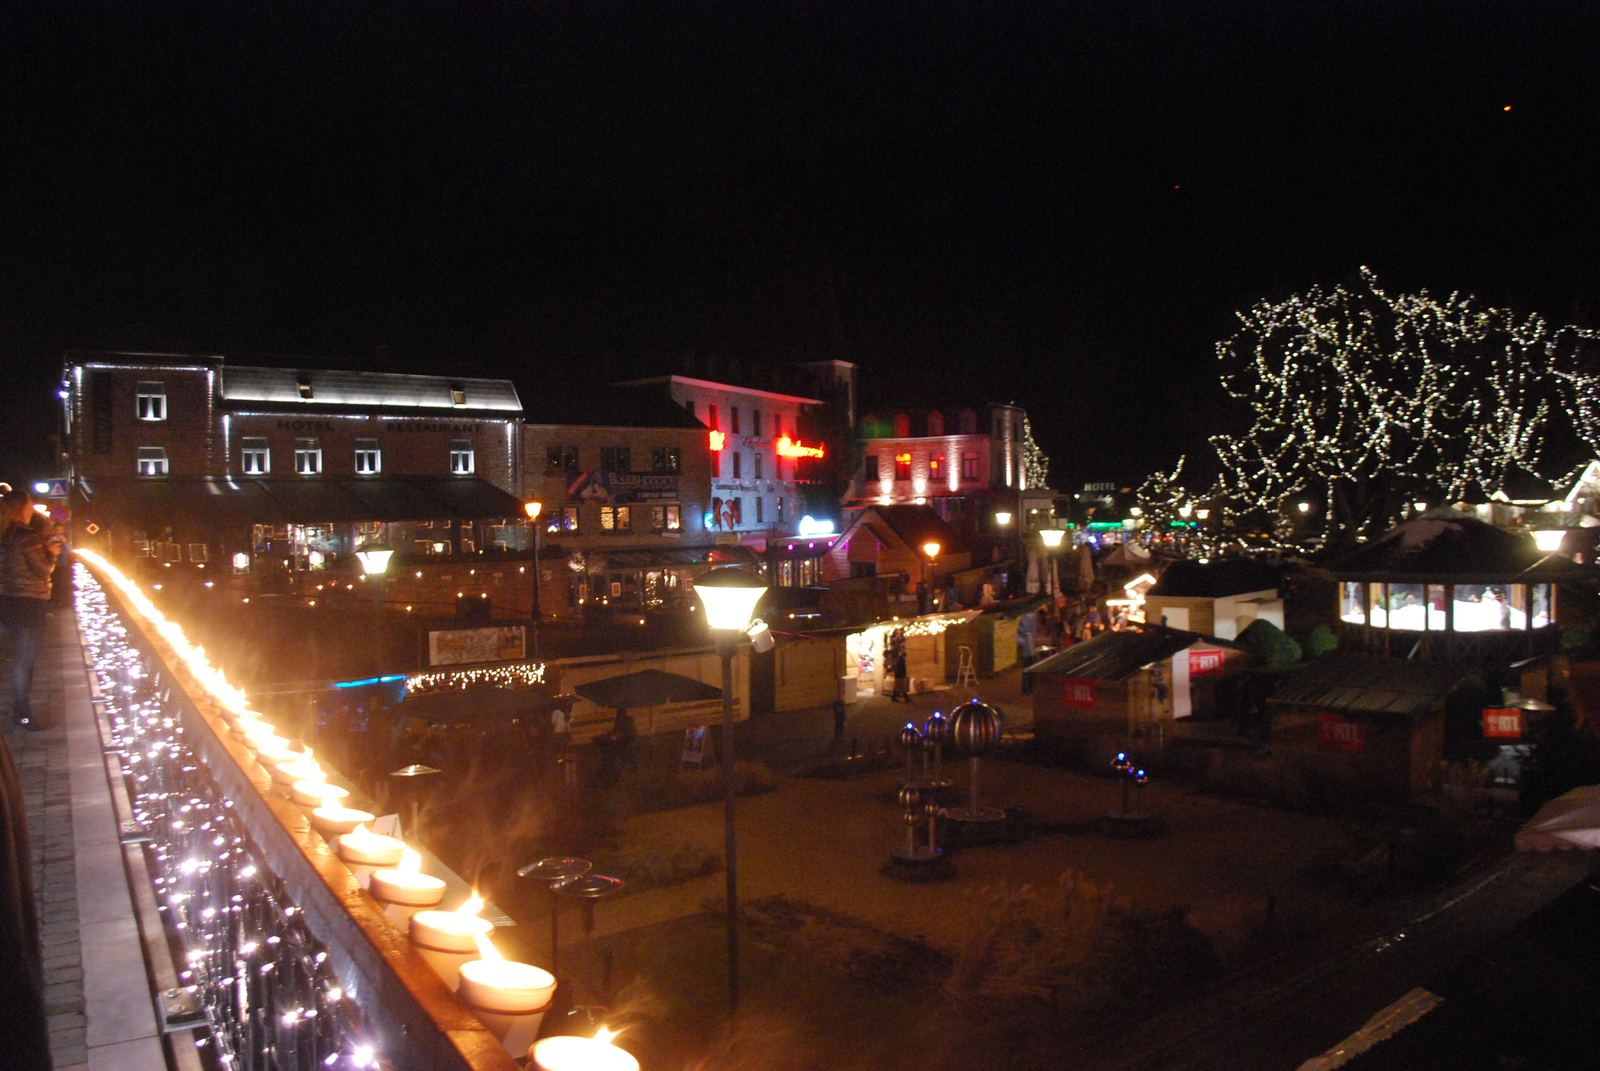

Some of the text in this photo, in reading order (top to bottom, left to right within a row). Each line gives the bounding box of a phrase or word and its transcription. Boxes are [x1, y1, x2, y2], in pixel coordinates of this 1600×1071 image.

[277, 419, 483, 433] HOTEL RESTAURANT
[1084, 482, 1115, 492] HOTEL
